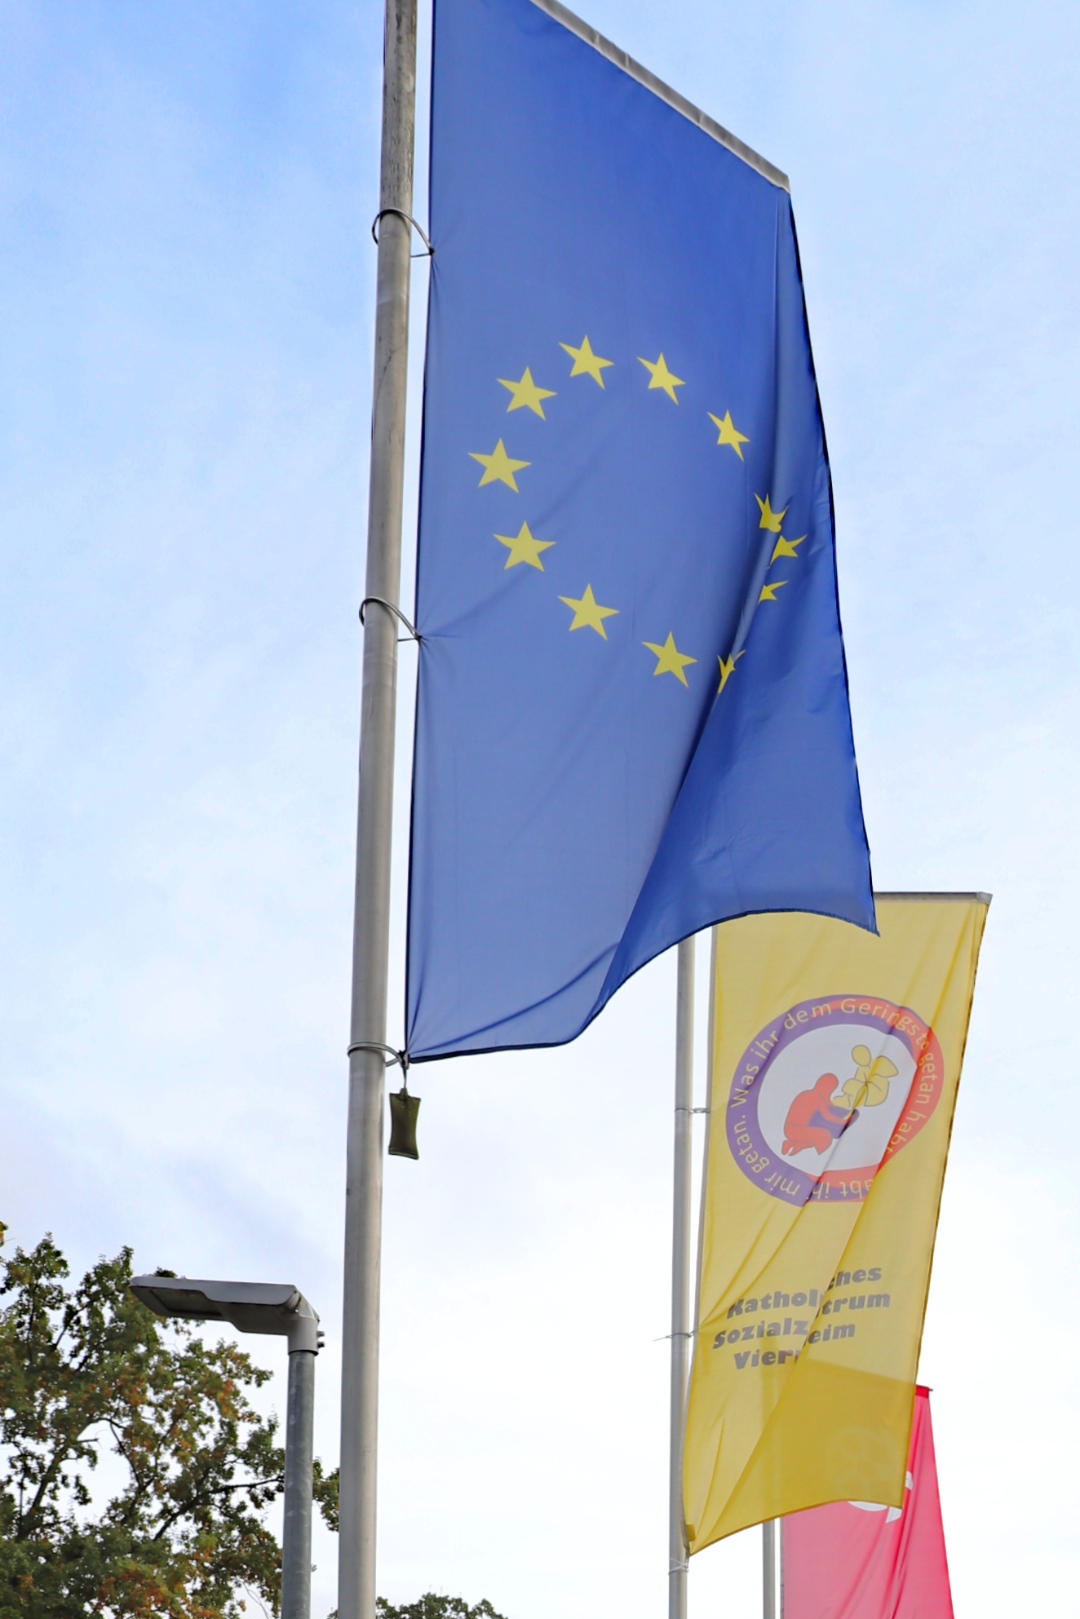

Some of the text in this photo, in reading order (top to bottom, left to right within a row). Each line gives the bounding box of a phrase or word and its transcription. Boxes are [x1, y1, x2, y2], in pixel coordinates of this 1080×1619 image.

[783, 1003, 831, 1031] dem
[840, 998, 930, 1051] Geringste
[751, 1031, 779, 1060] ihr
[731, 1065, 760, 1108] Was
[915, 1052, 938, 1105] getan
[764, 1171, 801, 1196] mir
[812, 1181, 831, 1199] ih
[713, 1293, 891, 1349] Sozialztrum
[733, 1323, 856, 1370] Viereim
